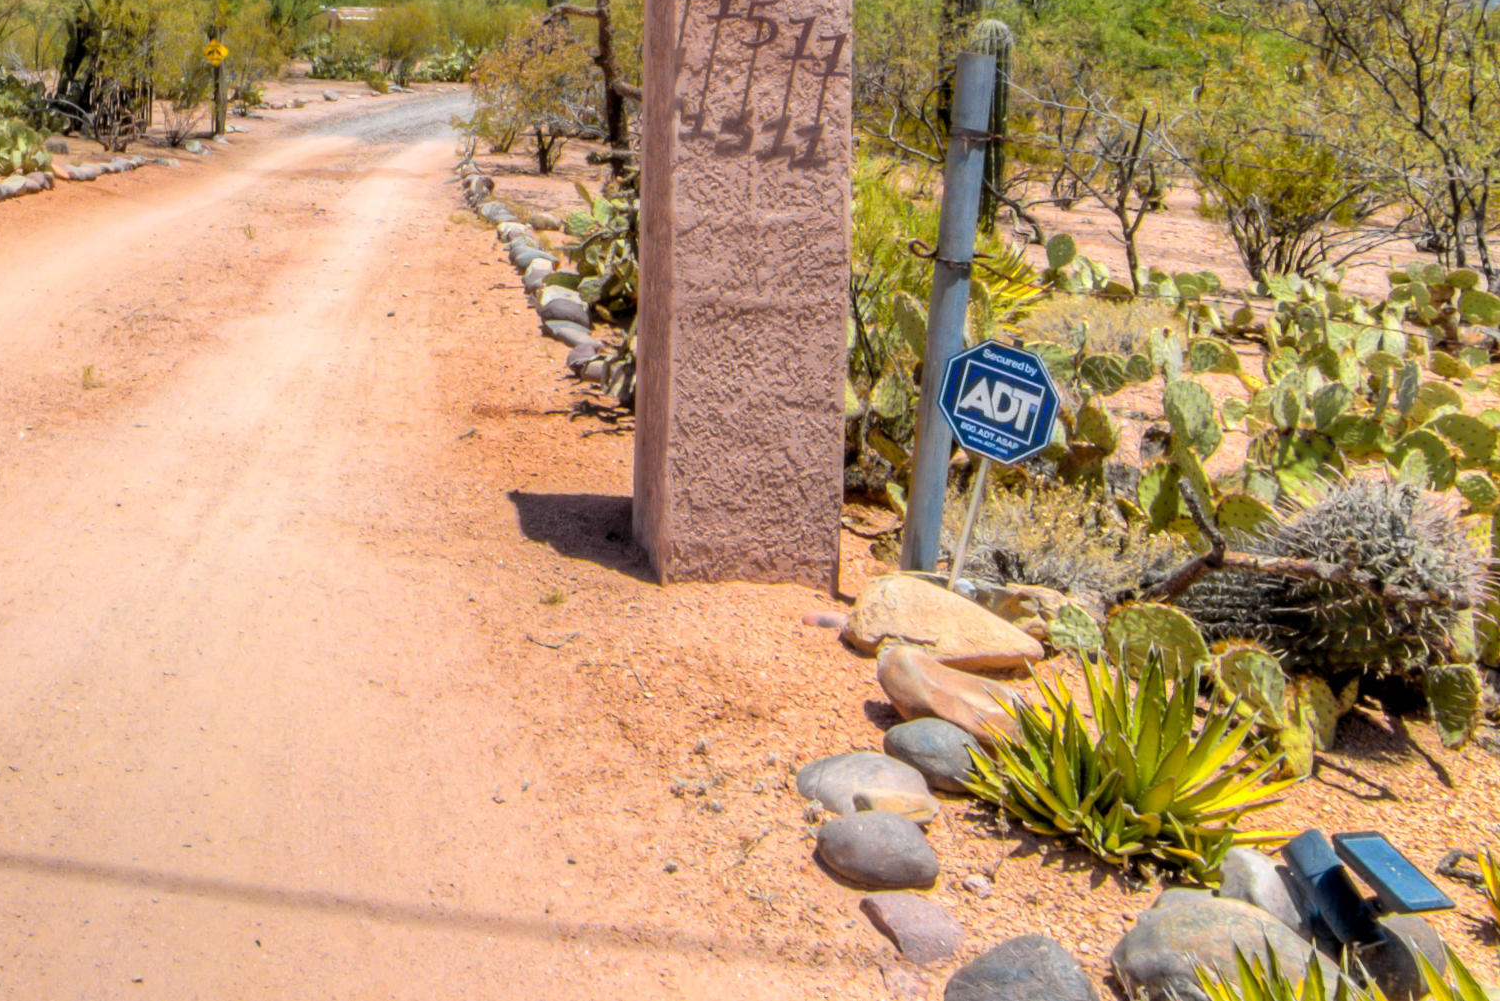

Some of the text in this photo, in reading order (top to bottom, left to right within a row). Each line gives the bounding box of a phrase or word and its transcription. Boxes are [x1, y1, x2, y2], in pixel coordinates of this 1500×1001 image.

[982, 348, 1038, 377] Secured by
[958, 376, 1041, 432] ADT
